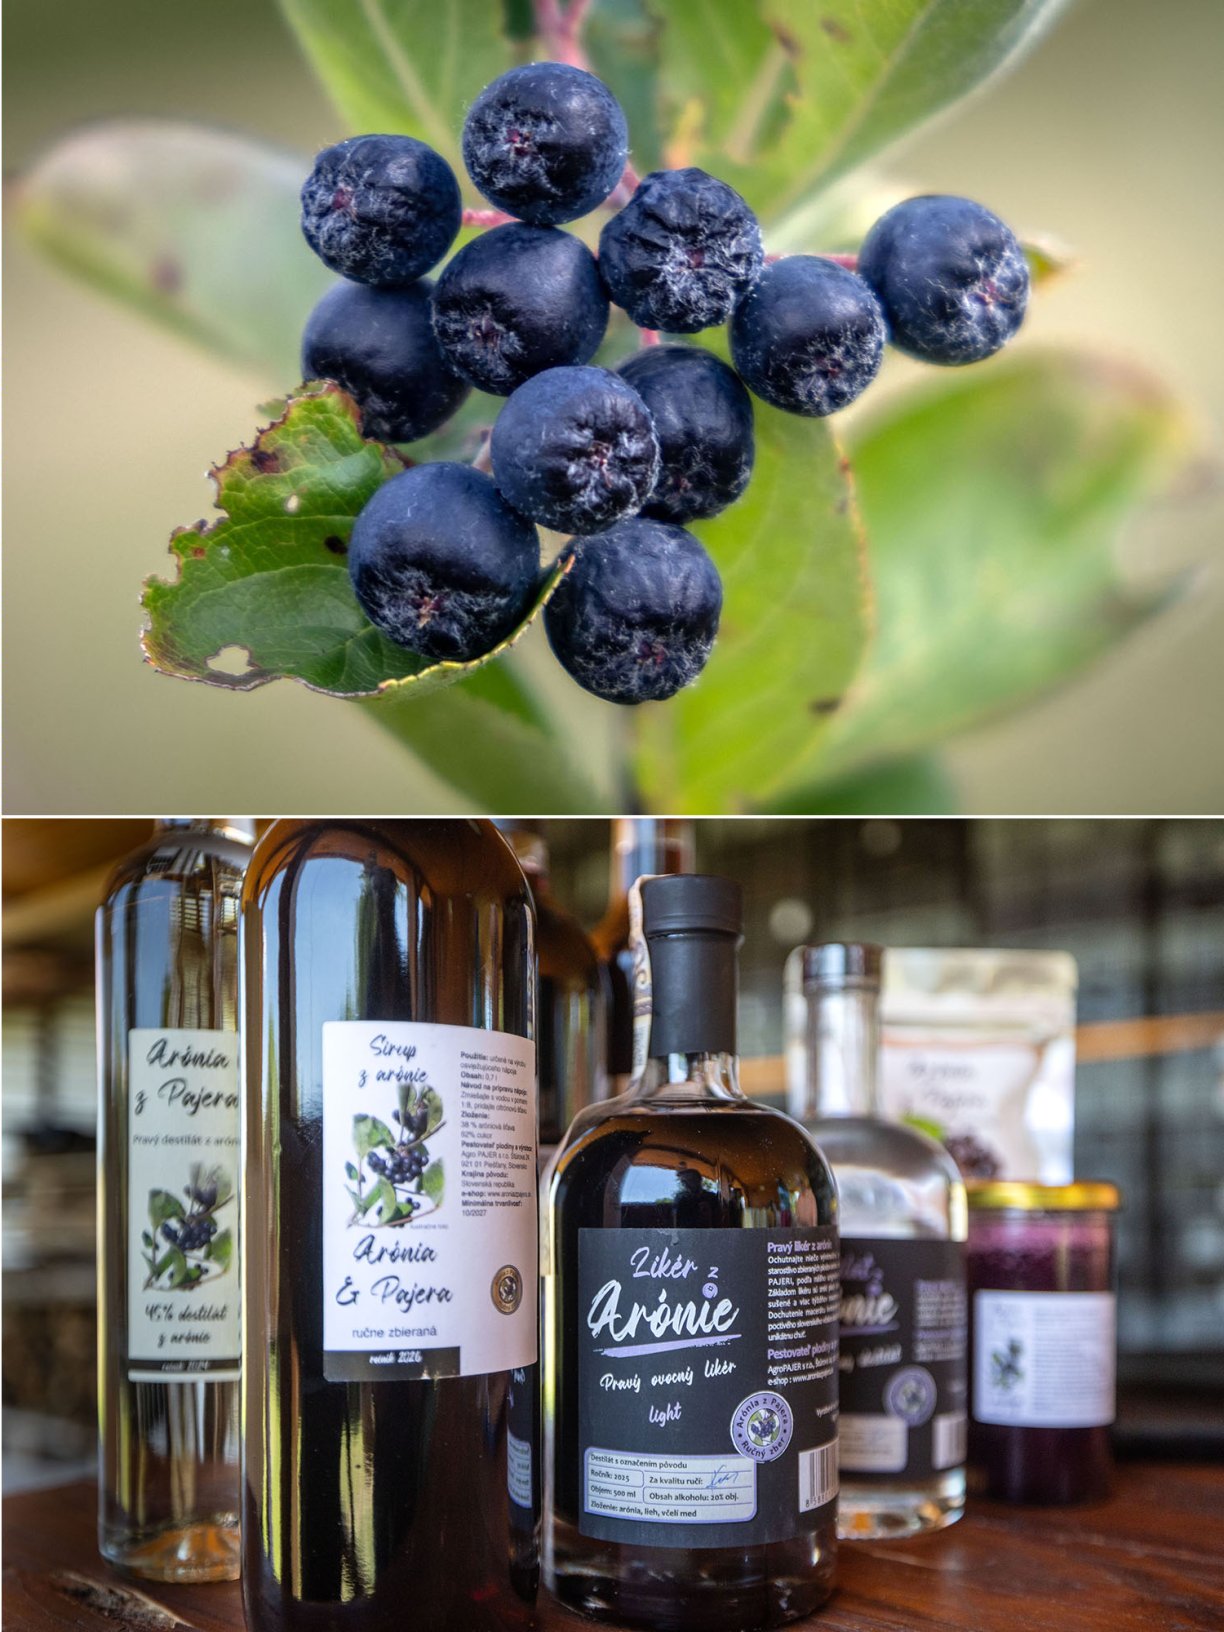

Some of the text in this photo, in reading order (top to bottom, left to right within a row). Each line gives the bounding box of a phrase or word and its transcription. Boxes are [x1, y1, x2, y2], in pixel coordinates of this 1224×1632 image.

[146, 1038, 229, 1068] Arónia
[369, 1034, 417, 1062] Sirup
[358, 1065, 429, 1088] z arónie
[461, 1071, 484, 1079] Obsah:
[135, 1077, 239, 1116] z Pajera
[353, 1234, 437, 1265] Arónia
[767, 1241, 793, 1255] Pravý
[768, 1255, 803, 1264] Ochutnajte
[768, 1278, 794, 1286] PAJERI,
[336, 1275, 360, 1306] &
[370, 1275, 453, 1314] Pajera
[587, 1279, 740, 1342] Arónie
[352, 1325, 437, 1339] ručne zbieraná
[599, 1358, 737, 1393] Pravý ovocný likér
[649, 1401, 682, 1428] light
[737, 1401, 759, 1428] Arónia
[742, 1438, 786, 1459] Ručný zber
[591, 1453, 614, 1465] Destilát
[620, 1459, 657, 1468] označením
[659, 1461, 687, 1470] pôvodu
[614, 1474, 630, 1483] 2025
[649, 1475, 703, 1485] Za kvalitu ručí:
[614, 1490, 625, 1498] 500
[626, 1489, 636, 1498] ml
[650, 1492, 672, 1500] Obsah
[674, 1492, 709, 1501] alkoholu:
[619, 1505, 643, 1515] arónia,
[644, 1507, 660, 1517] lieh,
[662, 1508, 679, 1517] včelí
[680, 1509, 697, 1517] med
